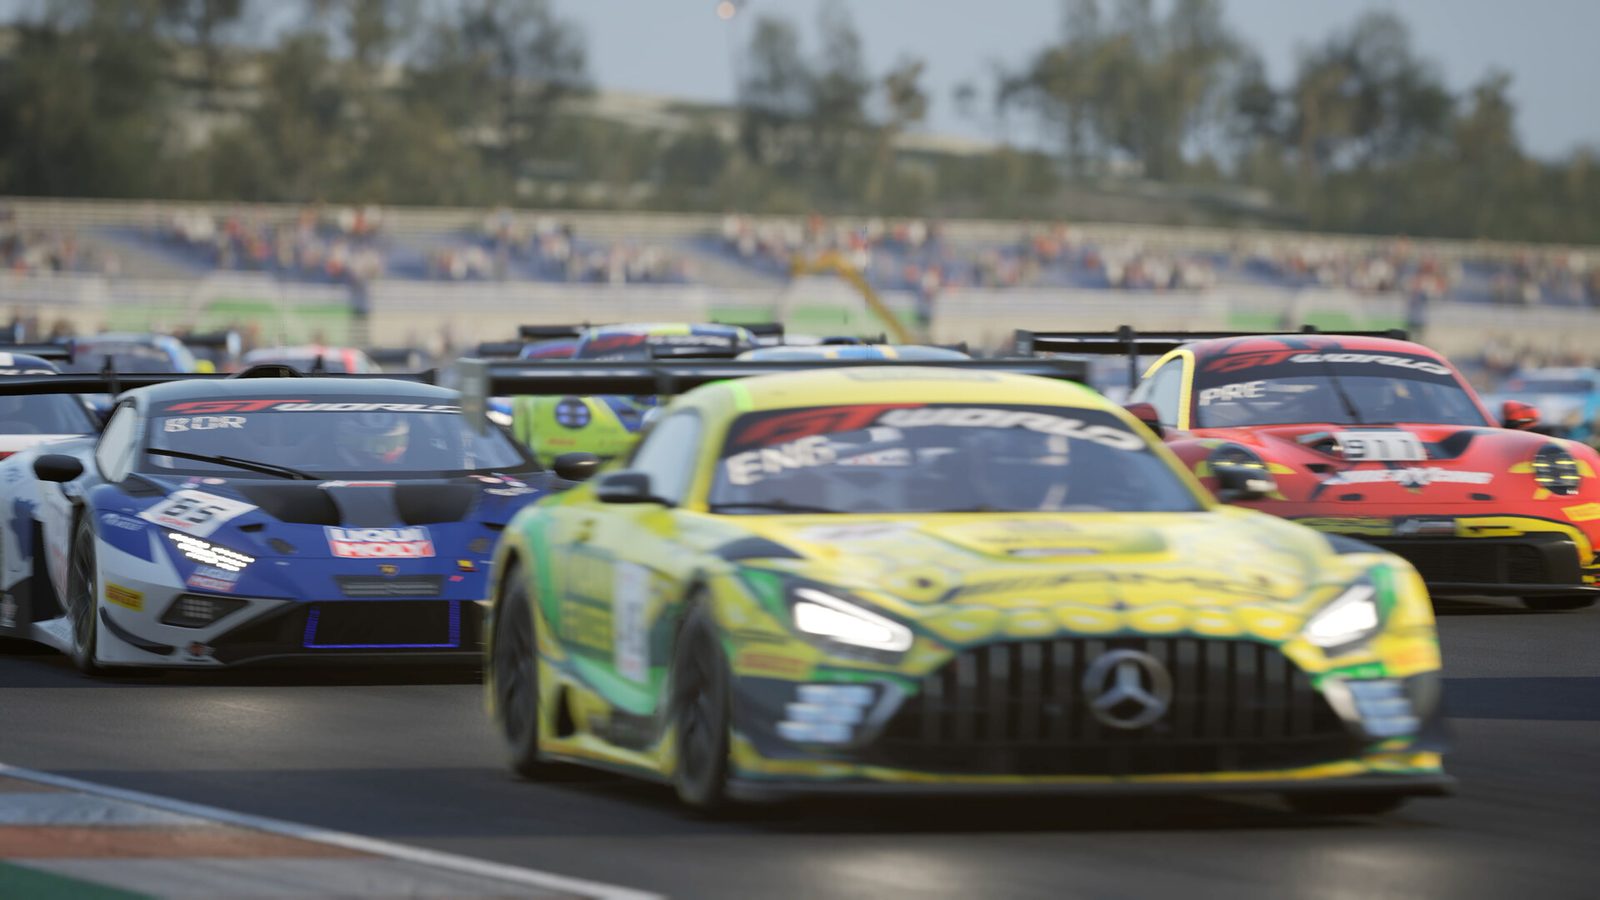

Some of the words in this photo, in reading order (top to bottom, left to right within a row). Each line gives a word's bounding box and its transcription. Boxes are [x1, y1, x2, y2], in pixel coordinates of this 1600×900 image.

[1204, 350, 1320, 373] GT
[1289, 353, 1453, 375] WORLD
[1199, 380, 1267, 406] PRE
[163, 399, 311, 414] GT
[164, 416, 248, 433] BOR
[734, 403, 928, 448] GT
[877, 408, 1147, 450] WORLD
[726, 435, 838, 485] ENG
[1344, 439, 1419, 460] 911
[332, 541, 432, 557] MOLY
